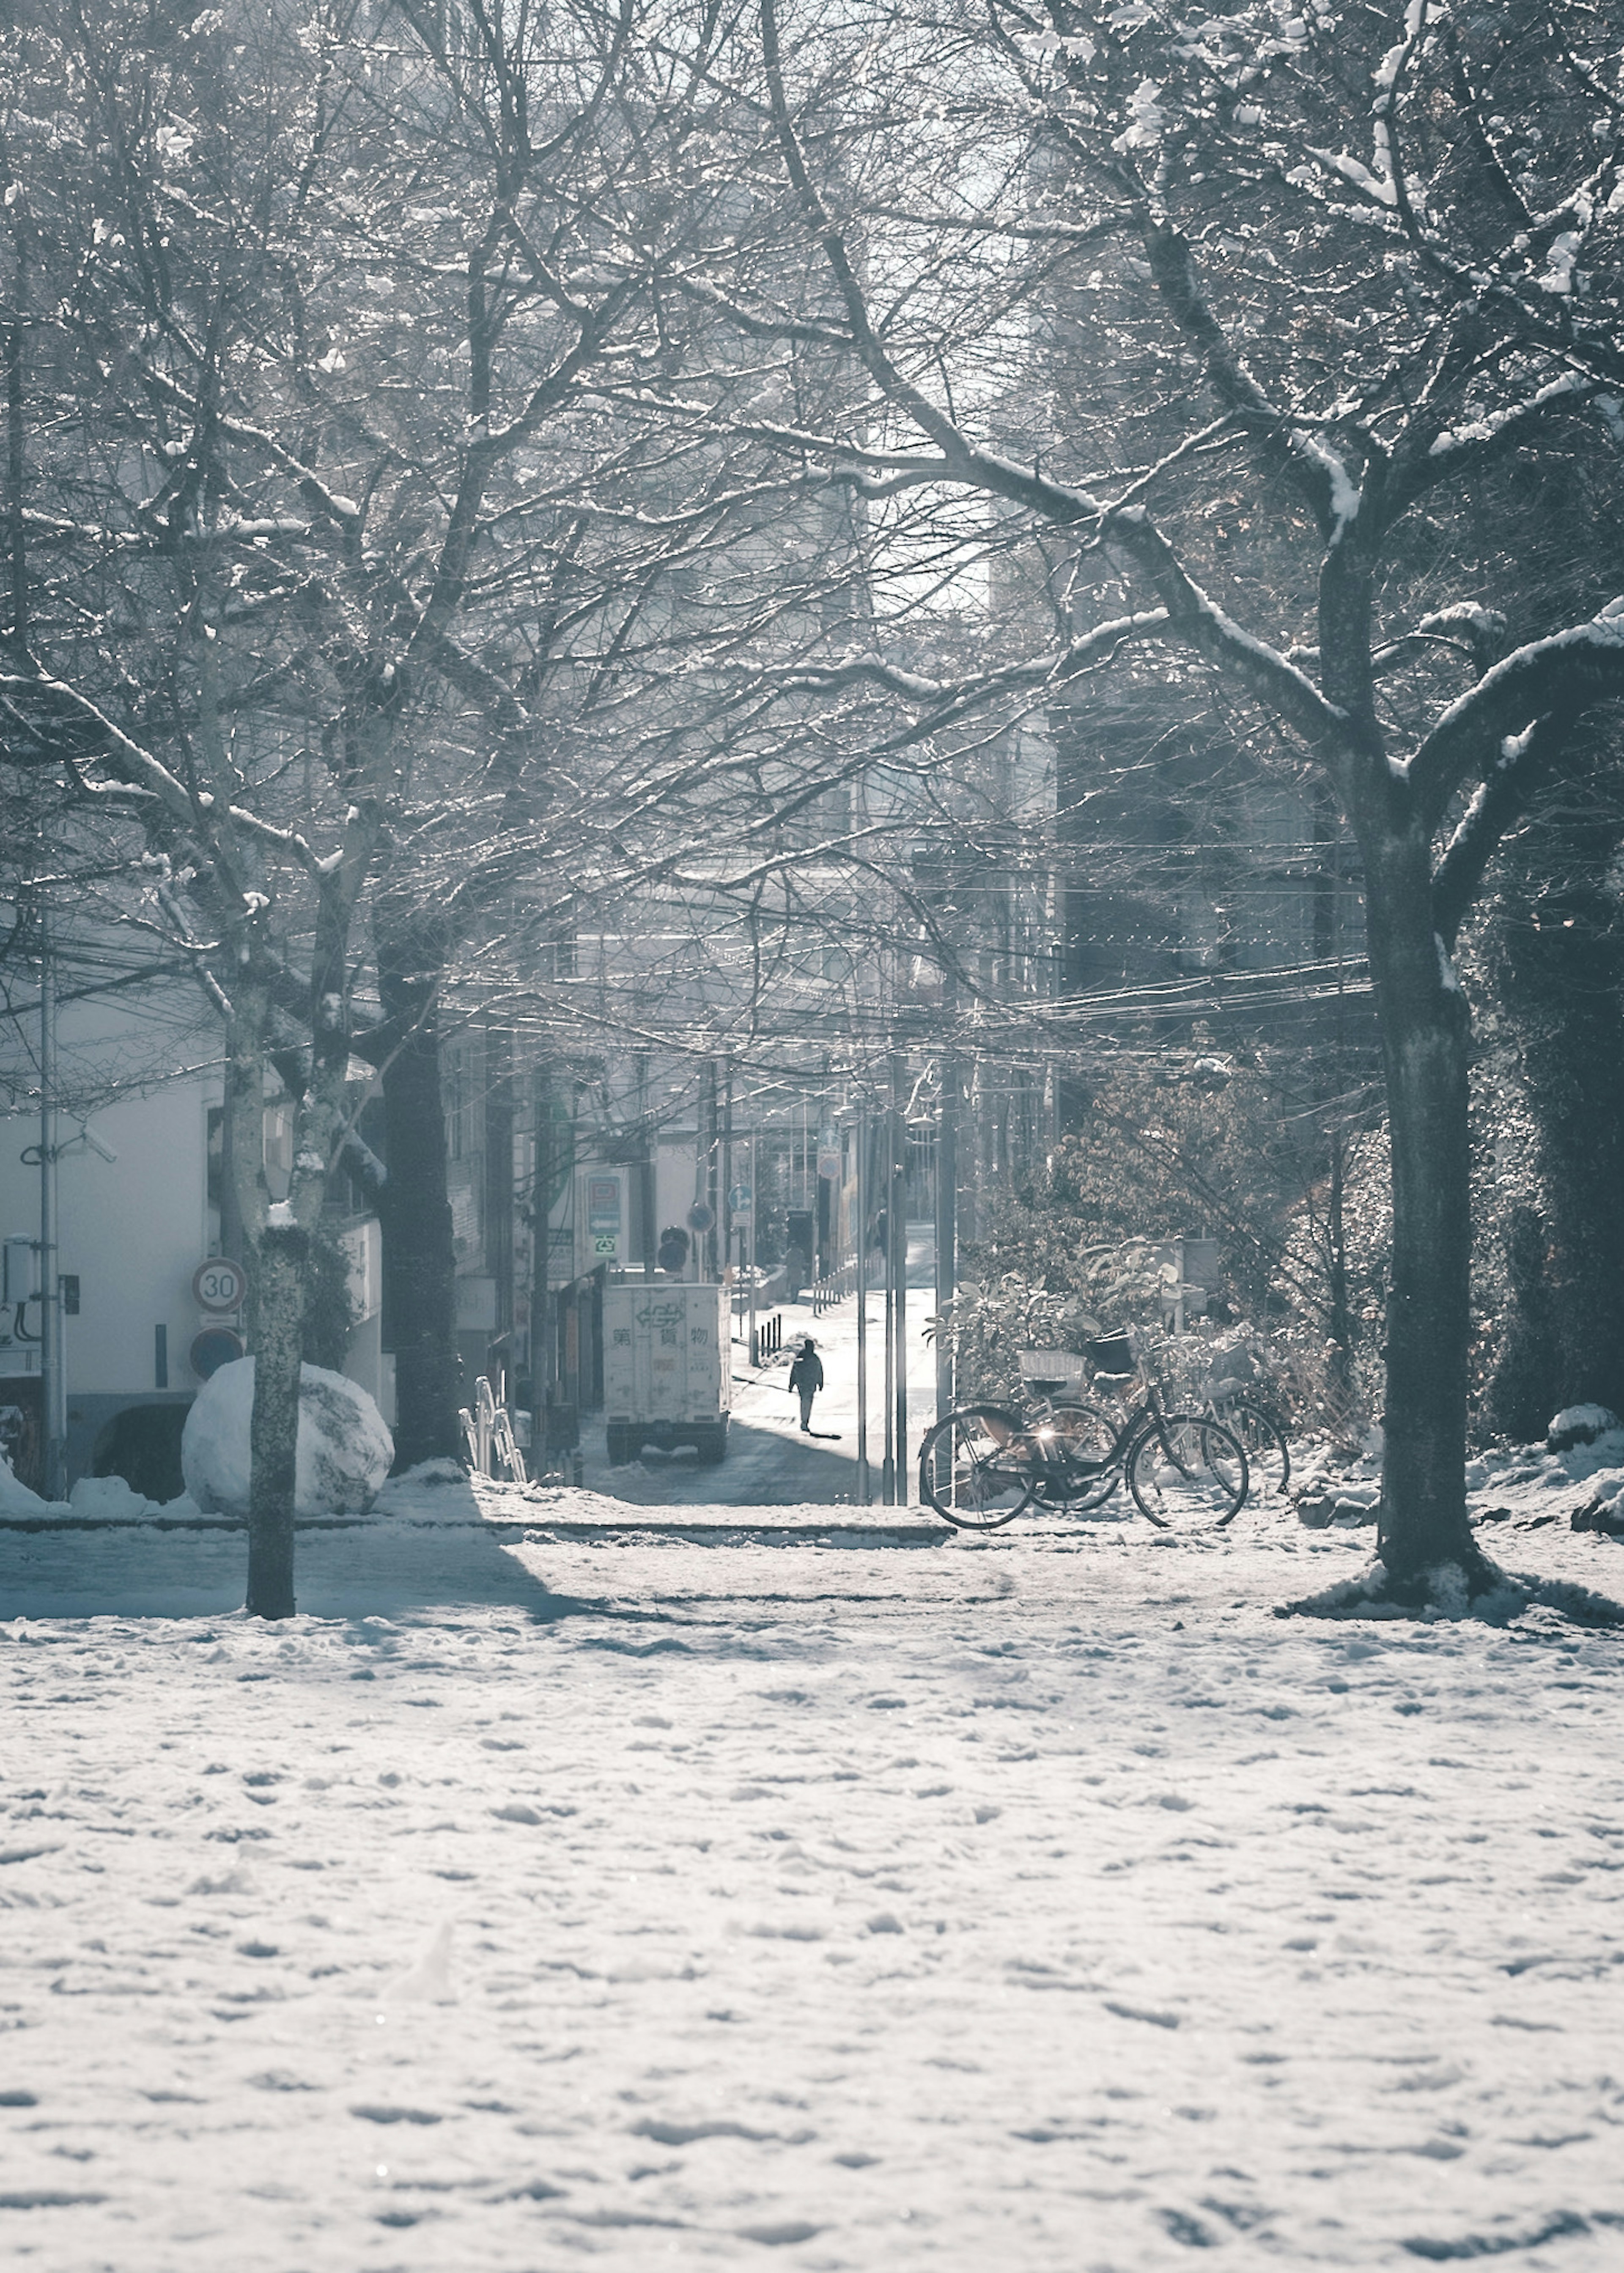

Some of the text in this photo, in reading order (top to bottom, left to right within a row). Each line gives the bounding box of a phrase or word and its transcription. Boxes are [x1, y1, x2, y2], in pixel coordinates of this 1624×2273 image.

[596, 1235, 614, 1255] 空
[205, 1274, 234, 1298] 30
[613, 1326, 708, 1346] 第一貨物
